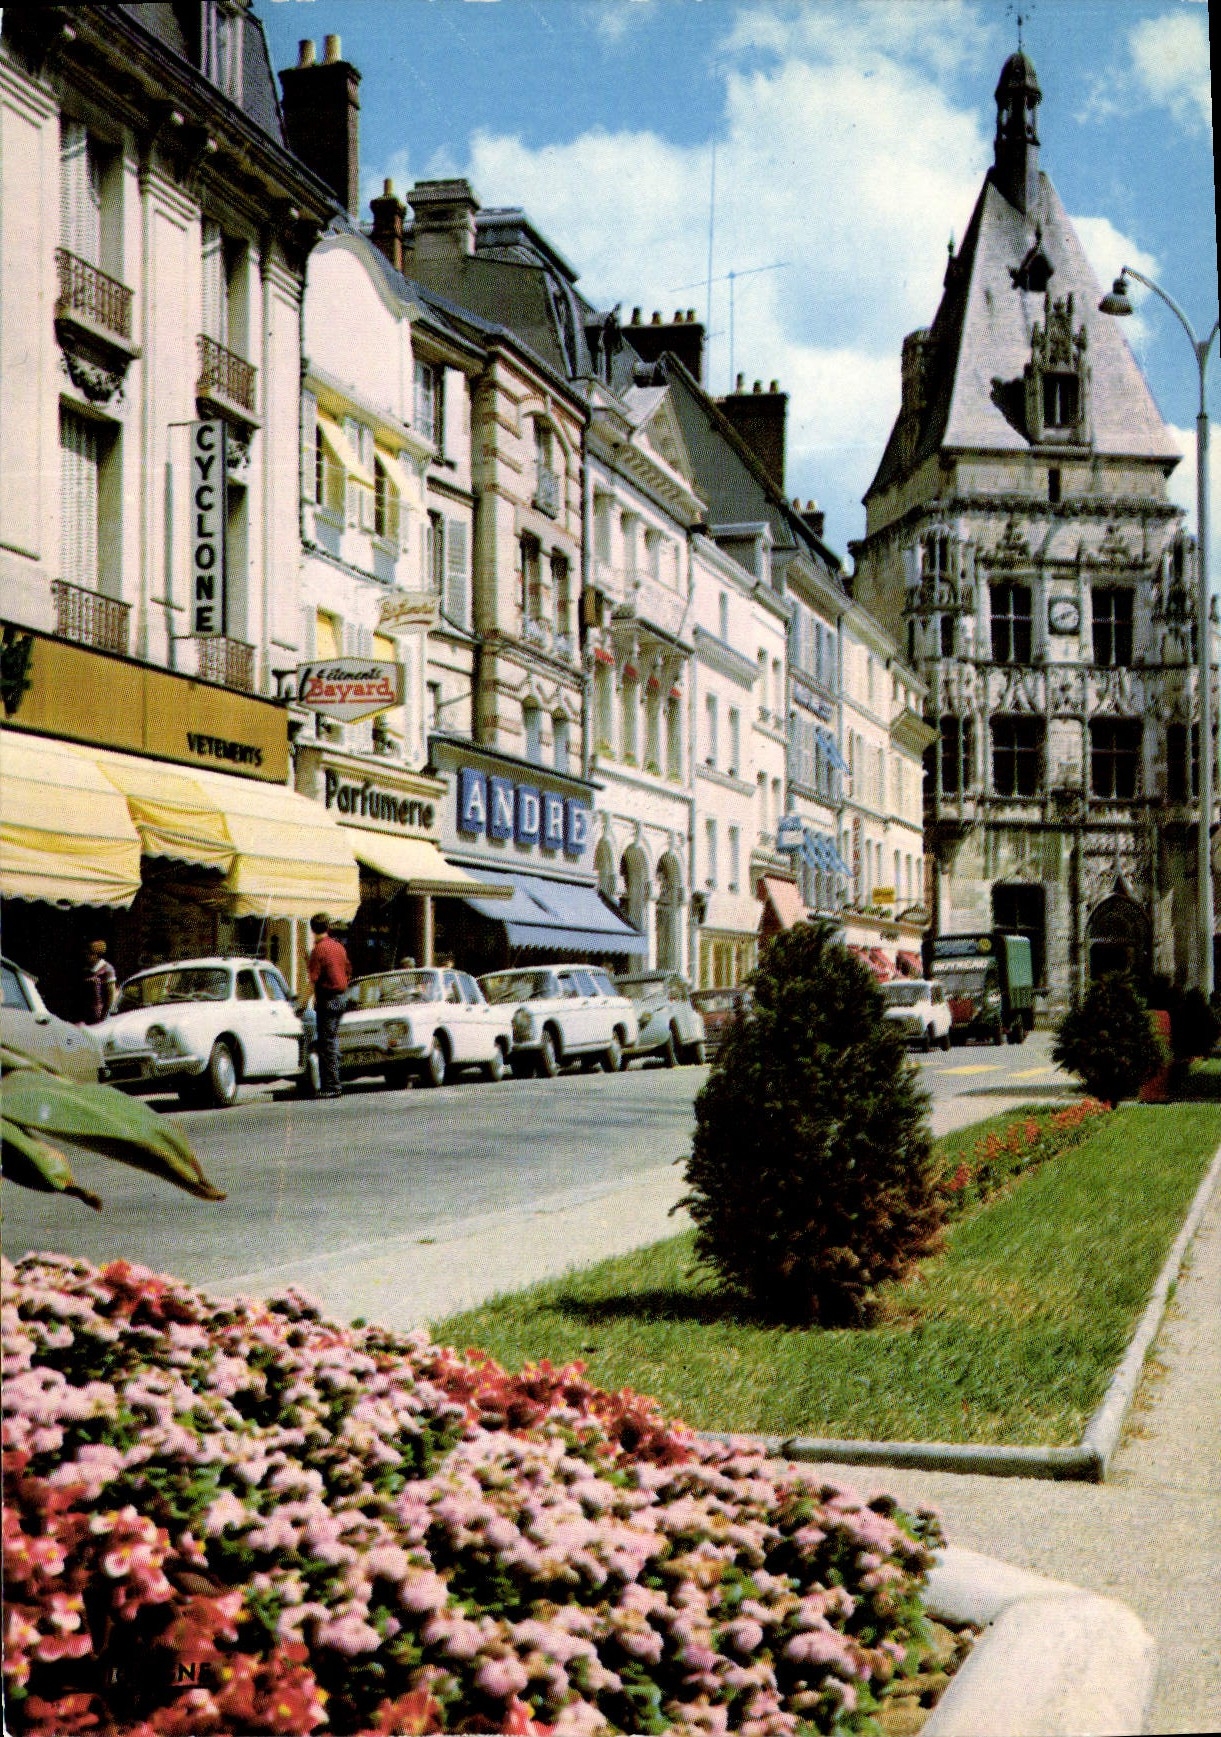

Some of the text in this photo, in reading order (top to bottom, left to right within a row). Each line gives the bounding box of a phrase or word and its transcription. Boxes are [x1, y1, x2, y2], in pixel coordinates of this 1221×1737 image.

[195, 424, 215, 632] CYCLONE
[306, 676, 396, 704] Bayard
[324, 767, 434, 831] Parfumerie
